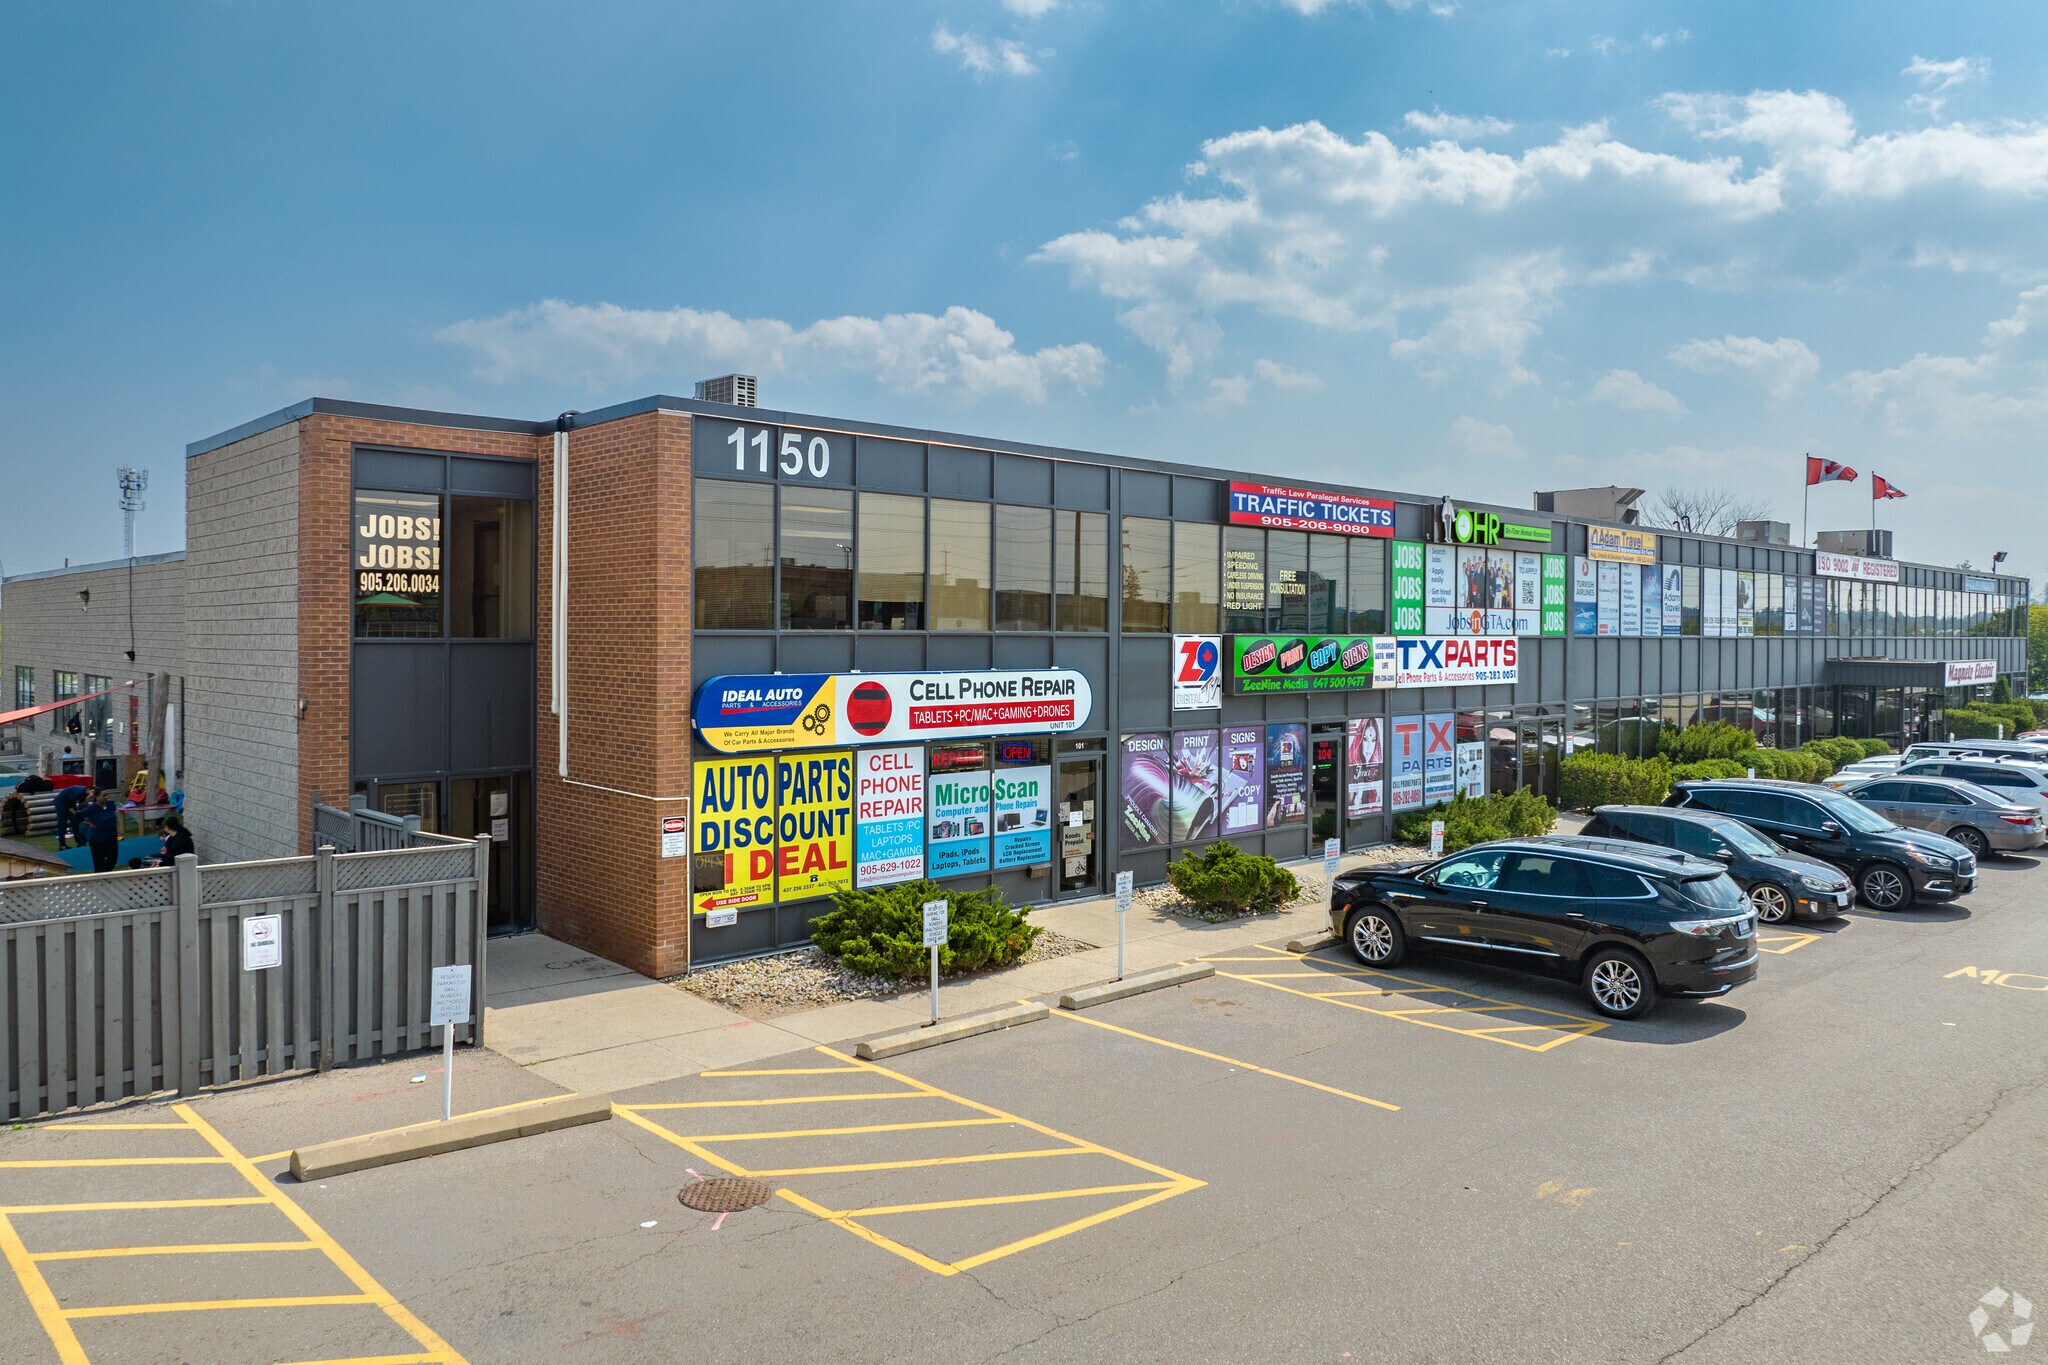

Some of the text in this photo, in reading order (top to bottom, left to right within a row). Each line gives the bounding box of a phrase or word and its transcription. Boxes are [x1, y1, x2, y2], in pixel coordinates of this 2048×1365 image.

[728, 427, 830, 478] 1150
[1262, 486, 1370, 506] Traffic Law Paralegal Services
[1234, 493, 1392, 526] TRAFFIC TICKETS
[360, 514, 441, 541] JOBS!
[1261, 516, 1370, 534] 905-206-9080
[1455, 508, 1500, 545] OHR
[1599, 529, 1643, 548] Adam Travel
[360, 544, 441, 570] JOBS!
[1226, 551, 1255, 560] IMPAIRED
[1395, 545, 1422, 569] JOBS
[1431, 548, 1447, 556] Search
[1226, 561, 1259, 570] SPEEDING
[1522, 557, 1535, 565] SCAN
[1544, 558, 1564, 579] JOBS
[1818, 556, 1897, 578] ISO 9002 REGISTERED
[1227, 571, 1247, 580] CARELESS
[1280, 570, 1296, 581] FREE
[1431, 568, 1444, 576] Apply
[1525, 567, 1538, 575] APPLY
[360, 572, 440, 593] 905.206.0034
[1227, 581, 1264, 590] UNDER SUSPENSION
[1395, 576, 1422, 600] JOBS
[1431, 576, 1444, 585] easily
[1577, 580, 1594, 588] TURKISH
[1269, 582, 1306, 595] CONSULTATION
[1441, 588, 1452, 596] hired
[1544, 585, 1564, 606] JOBS
[1576, 589, 1594, 597] AIRLINES
[1431, 596, 1447, 605] quickly
[1664, 593, 1680, 602] Adam
[1226, 601, 1262, 610] RED LIGHT
[1665, 603, 1680, 612] Travel
[1395, 607, 1422, 631] JOBS
[1446, 612, 1528, 631] JobsinGTA.com
[1544, 611, 1564, 631] JOBS
[1178, 641, 1218, 682] Z9
[1243, 643, 1276, 671] DESIGN
[1280, 644, 1304, 669] PRINT
[1310, 642, 1337, 669] COPY
[1342, 642, 1369, 669] SIGNS
[1406, 673, 1422, 683] Phone
[1423, 673, 1437, 682] Parts
[1438, 672, 1443, 680] &
[1444, 671, 1475, 681] Accessories
[1475, 671, 1501, 680] 905-282
[1502, 670, 1516, 679] 0051
[1948, 663, 1995, 684] Magneto Electric
[909, 676, 1075, 701] CELL PHONE REPAIR
[1243, 679, 1282, 691] ZeeNine
[1283, 678, 1309, 689] Media
[1313, 678, 1329, 688] 647
[1330, 677, 1346, 688] 500
[1346, 676, 1365, 687] 9477
[722, 688, 803, 703] IDEAL AUTO
[1177, 693, 1203, 704] DIGITAL
[762, 700, 802, 708] ACCESSORIES
[734, 730, 749, 739] Carry
[760, 729, 775, 737] Major
[763, 736, 795, 744] Accessories
[1183, 736, 1209, 747] PRINT
[1231, 732, 1256, 744] SIGNS
[1003, 747, 1030, 759] OPEN
[1128, 739, 1164, 752] DESIGN
[869, 753, 913, 772] CELL
[1318, 750, 1332, 760] 104
[1402, 757, 1452, 772] PARTS
[701, 758, 850, 814] AUTO PARTS
[860, 774, 922, 796] PHONE
[1238, 785, 1261, 797] COPY
[935, 779, 1038, 807] Micro Scan
[860, 797, 922, 819] REPAIR
[935, 799, 1038, 819] Computer and Phone Repairs
[1124, 804, 1151, 843] ZeeNine
[1126, 795, 1159, 837] PROUDLY CANADIAN
[701, 808, 850, 851] DISCOUNT
[864, 820, 921, 835] TABLETS /PC
[871, 834, 913, 848] LAPTOPS
[1064, 831, 1081, 840] Koodo
[1064, 838, 1085, 846] Prepaid.
[861, 845, 923, 862] MAC+GAMING
[939, 848, 980, 860] iPads, iPods
[1005, 842, 1024, 851] Cracked
[1013, 847, 1042, 857] Replacement
[695, 855, 725, 870] OPEN
[725, 841, 848, 884] I DEAL
[932, 856, 986, 871] Laptops, Tablets
[999, 853, 1046, 865] Battery Replacement
[860, 859, 921, 875] 905-629-1022
[860, 870, 922, 883] info@microscancomputer.ca
[728, 897, 741, 905] SIDE
[741, 895, 757, 903] DOOR
